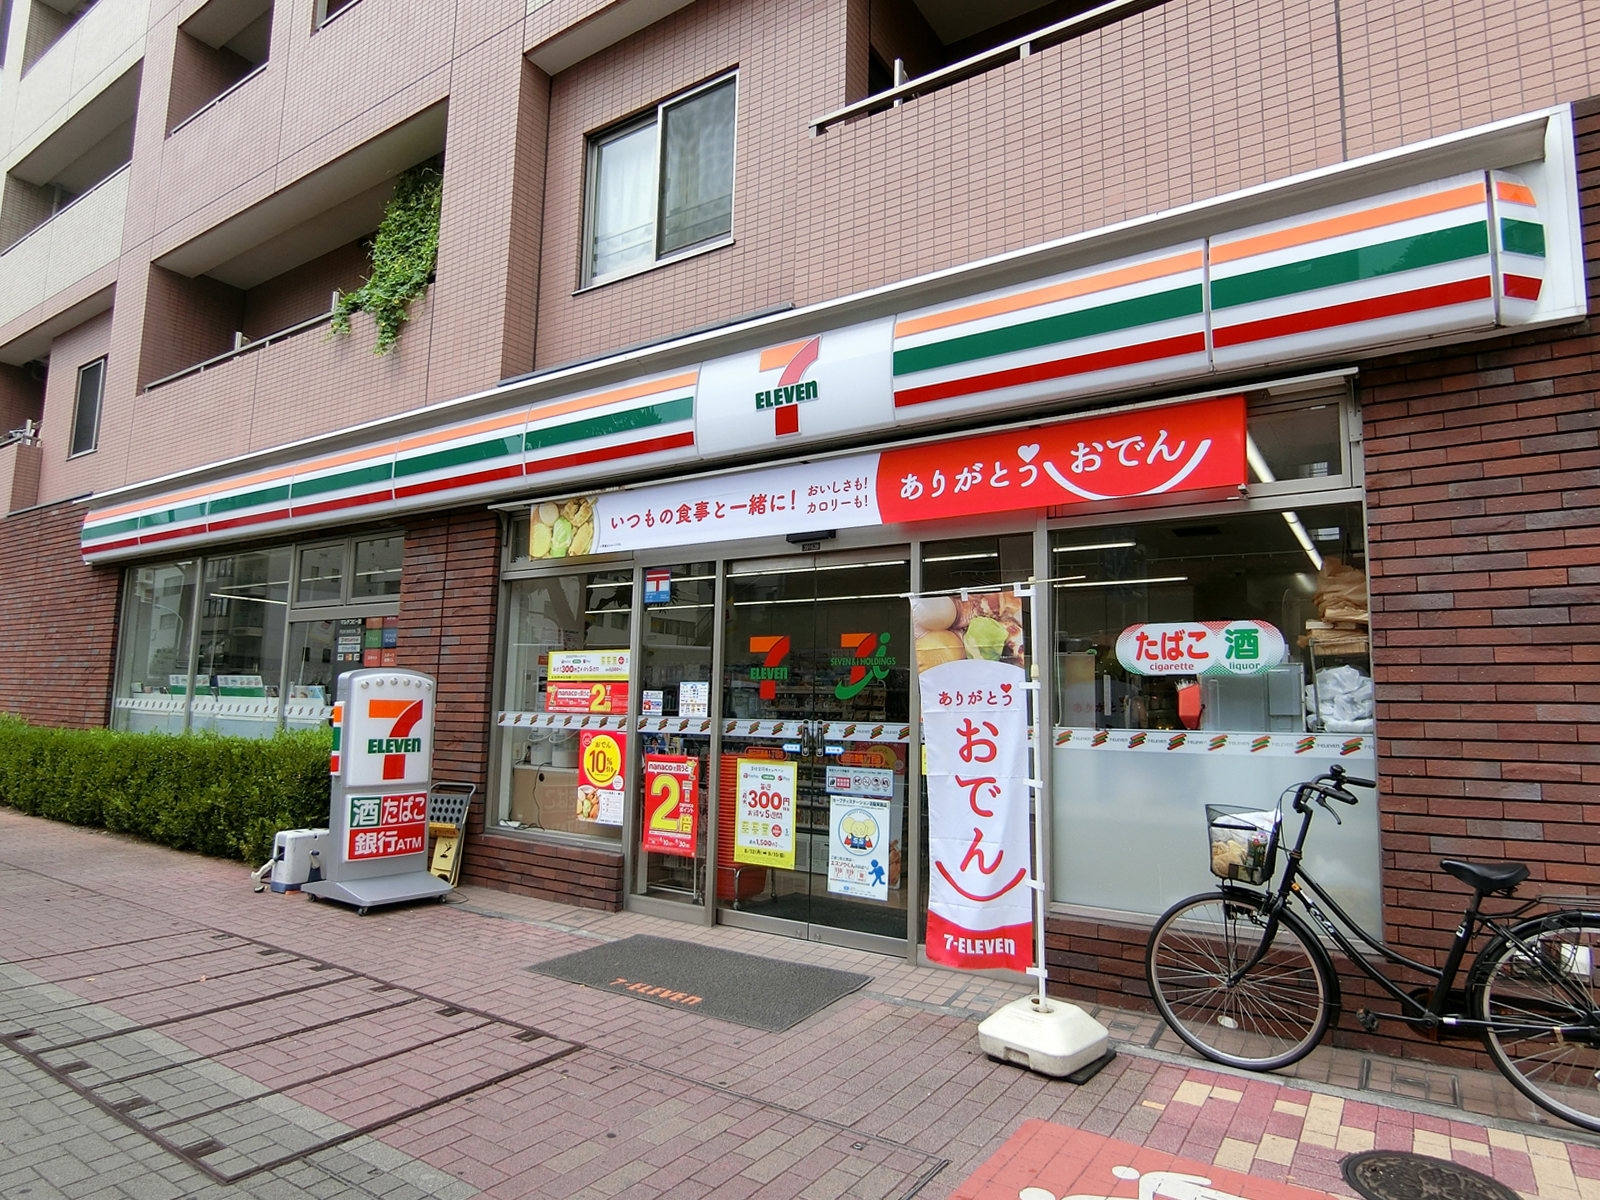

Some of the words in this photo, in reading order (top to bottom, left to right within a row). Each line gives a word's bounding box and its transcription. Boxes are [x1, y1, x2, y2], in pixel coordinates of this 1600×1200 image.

[900, 462, 1038, 500] ありがとう
[1070, 429, 1185, 473] おでん
[807, 477, 868, 497] おいしさも!
[611, 490, 796, 530] いつもの食事と一緒に!
[806, 495, 868, 514] カロリーも!
[1135, 629, 1209, 661] たばこ
[1225, 628, 1259, 660] 酒
[861, 657, 896, 666] HOLDINGS
[1149, 662, 1194, 672] cigarette
[1229, 661, 1261, 672] liquor
[938, 690, 1012, 706] ありがとう
[595, 741, 611, 749] おでん
[383, 795, 425, 824] たばこ
[650, 773, 680, 832] 2
[955, 718, 1004, 874] おでん
[352, 798, 381, 827] 酒
